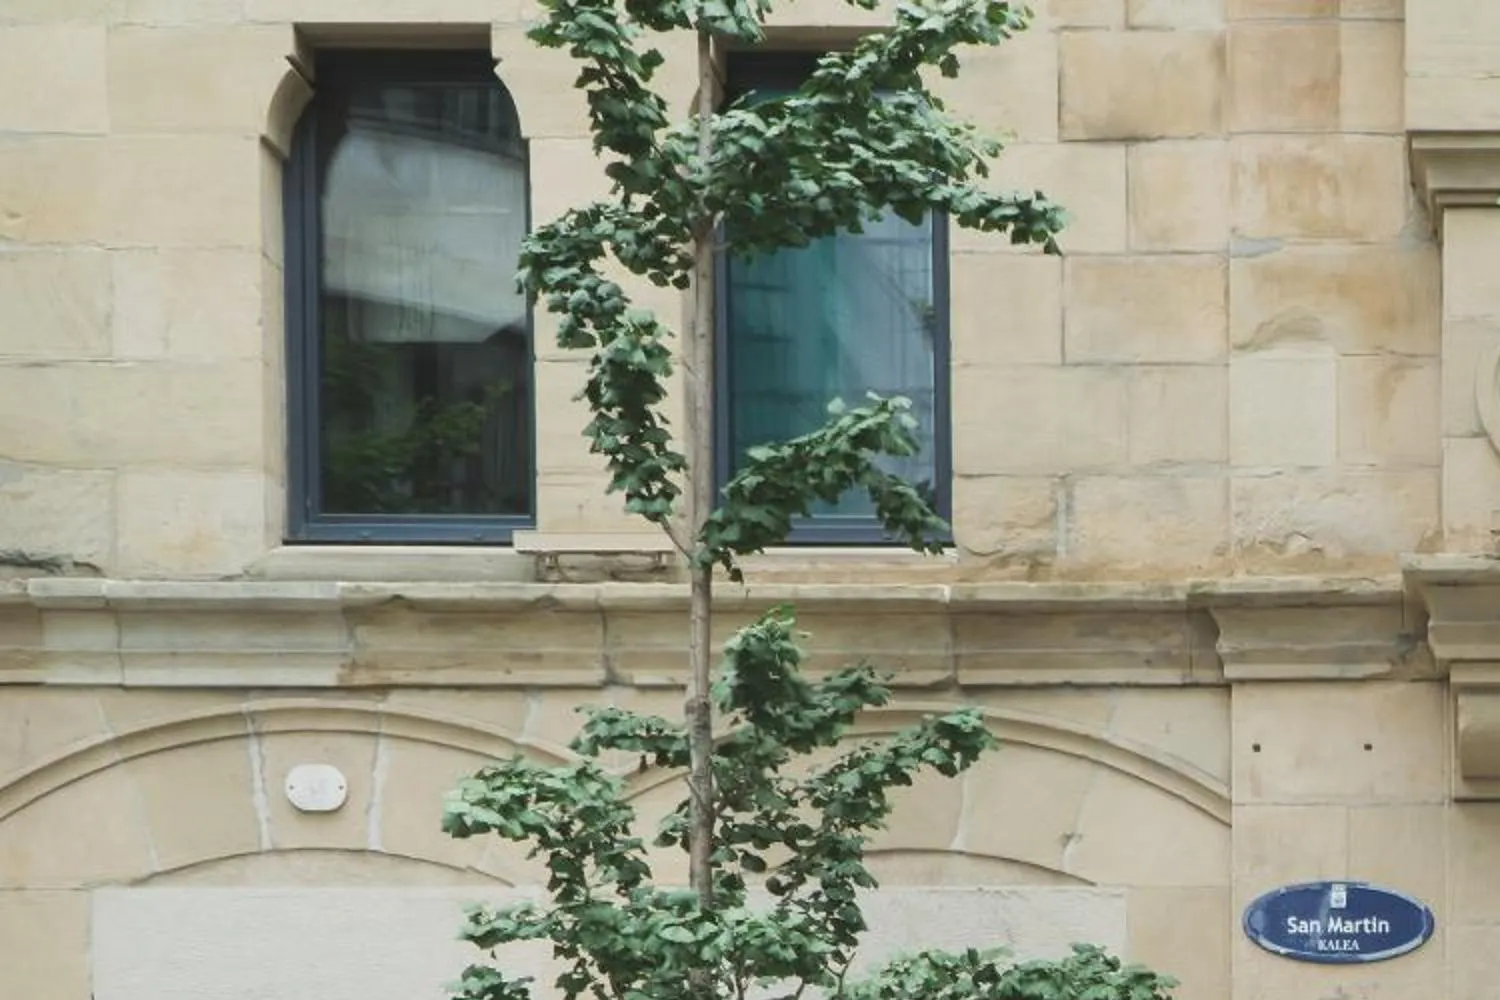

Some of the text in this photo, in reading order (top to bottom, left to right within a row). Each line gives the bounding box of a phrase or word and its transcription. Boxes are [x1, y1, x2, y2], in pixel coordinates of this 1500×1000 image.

[1286, 916, 1390, 934] San Martin
[1317, 939, 1361, 951] KALEA
